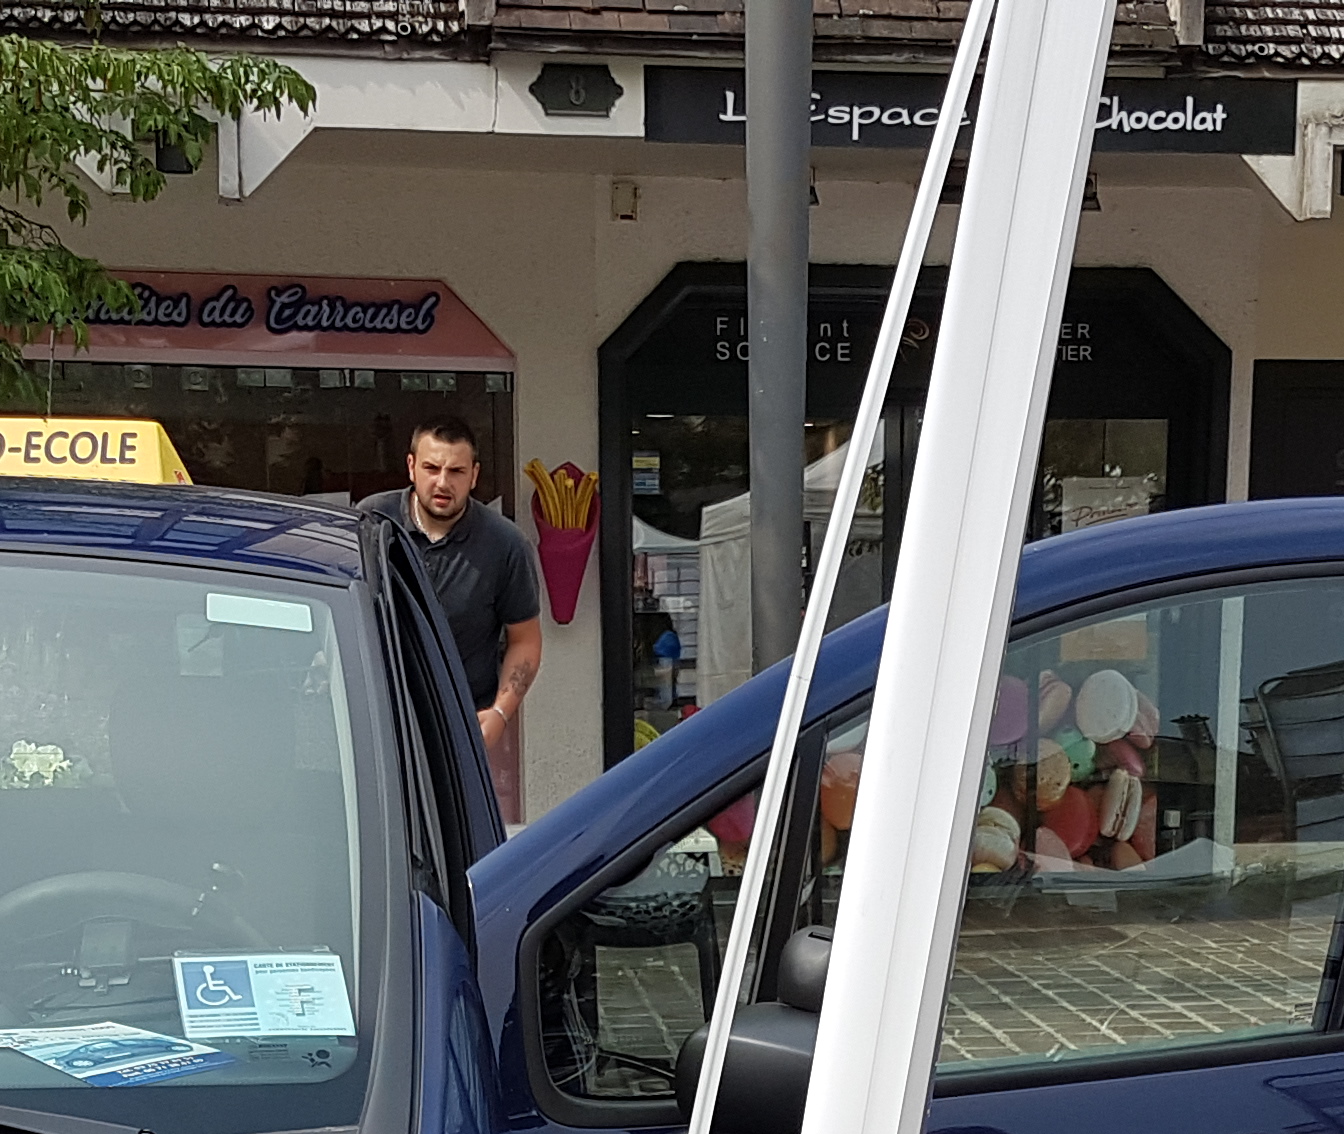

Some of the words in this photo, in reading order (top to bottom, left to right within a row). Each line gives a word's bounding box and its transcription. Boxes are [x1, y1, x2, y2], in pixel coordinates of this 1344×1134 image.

[568, 75, 586, 106] 8
[202, 285, 252, 325] du
[267, 286, 438, 333] Carrousel
[716, 316, 850, 337] Flnt
